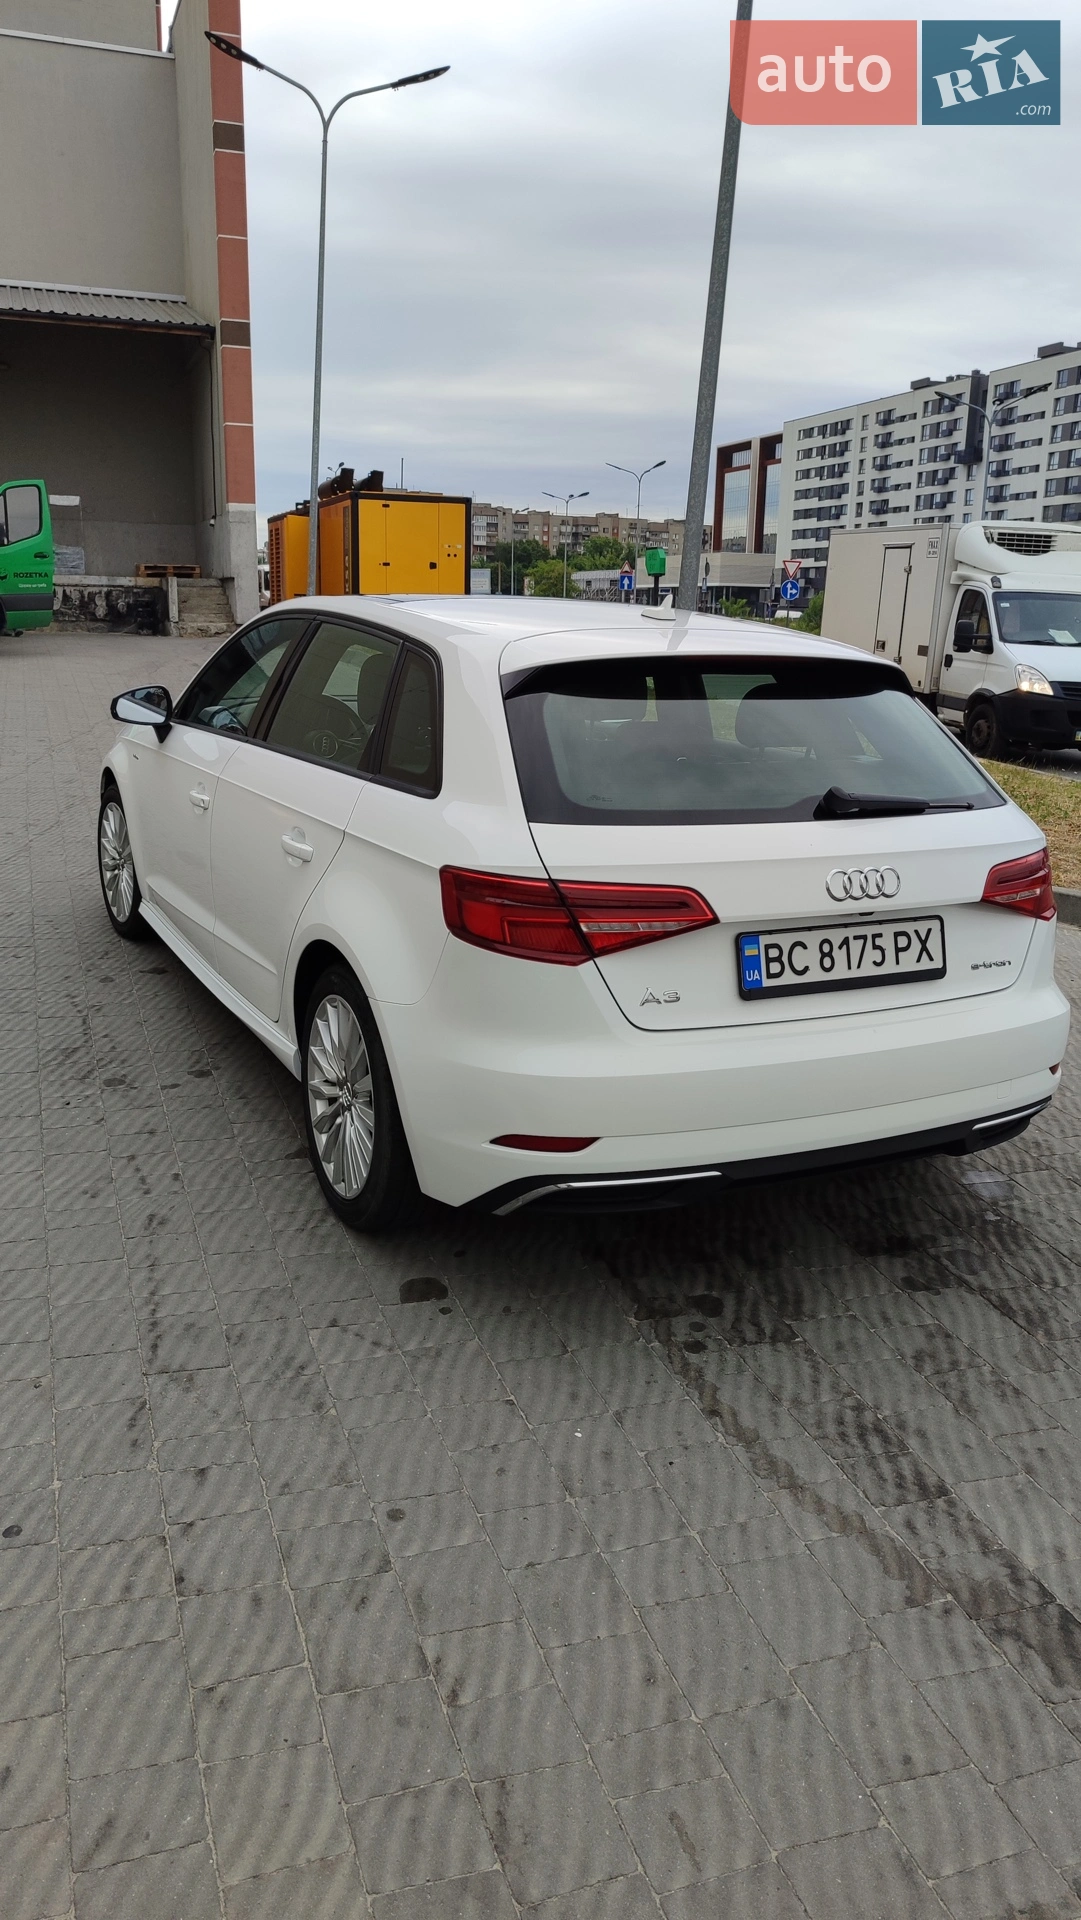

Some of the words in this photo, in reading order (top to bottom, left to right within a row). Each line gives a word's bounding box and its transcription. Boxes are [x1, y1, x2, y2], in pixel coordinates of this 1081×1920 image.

[13, 571, 49, 579] ROZETKA
[764, 940, 810, 980] BC
[818, 932, 887, 973] 8175
[893, 927, 935, 966] PX
[745, 969, 761, 982] UA
[639, 986, 681, 1007] A3
